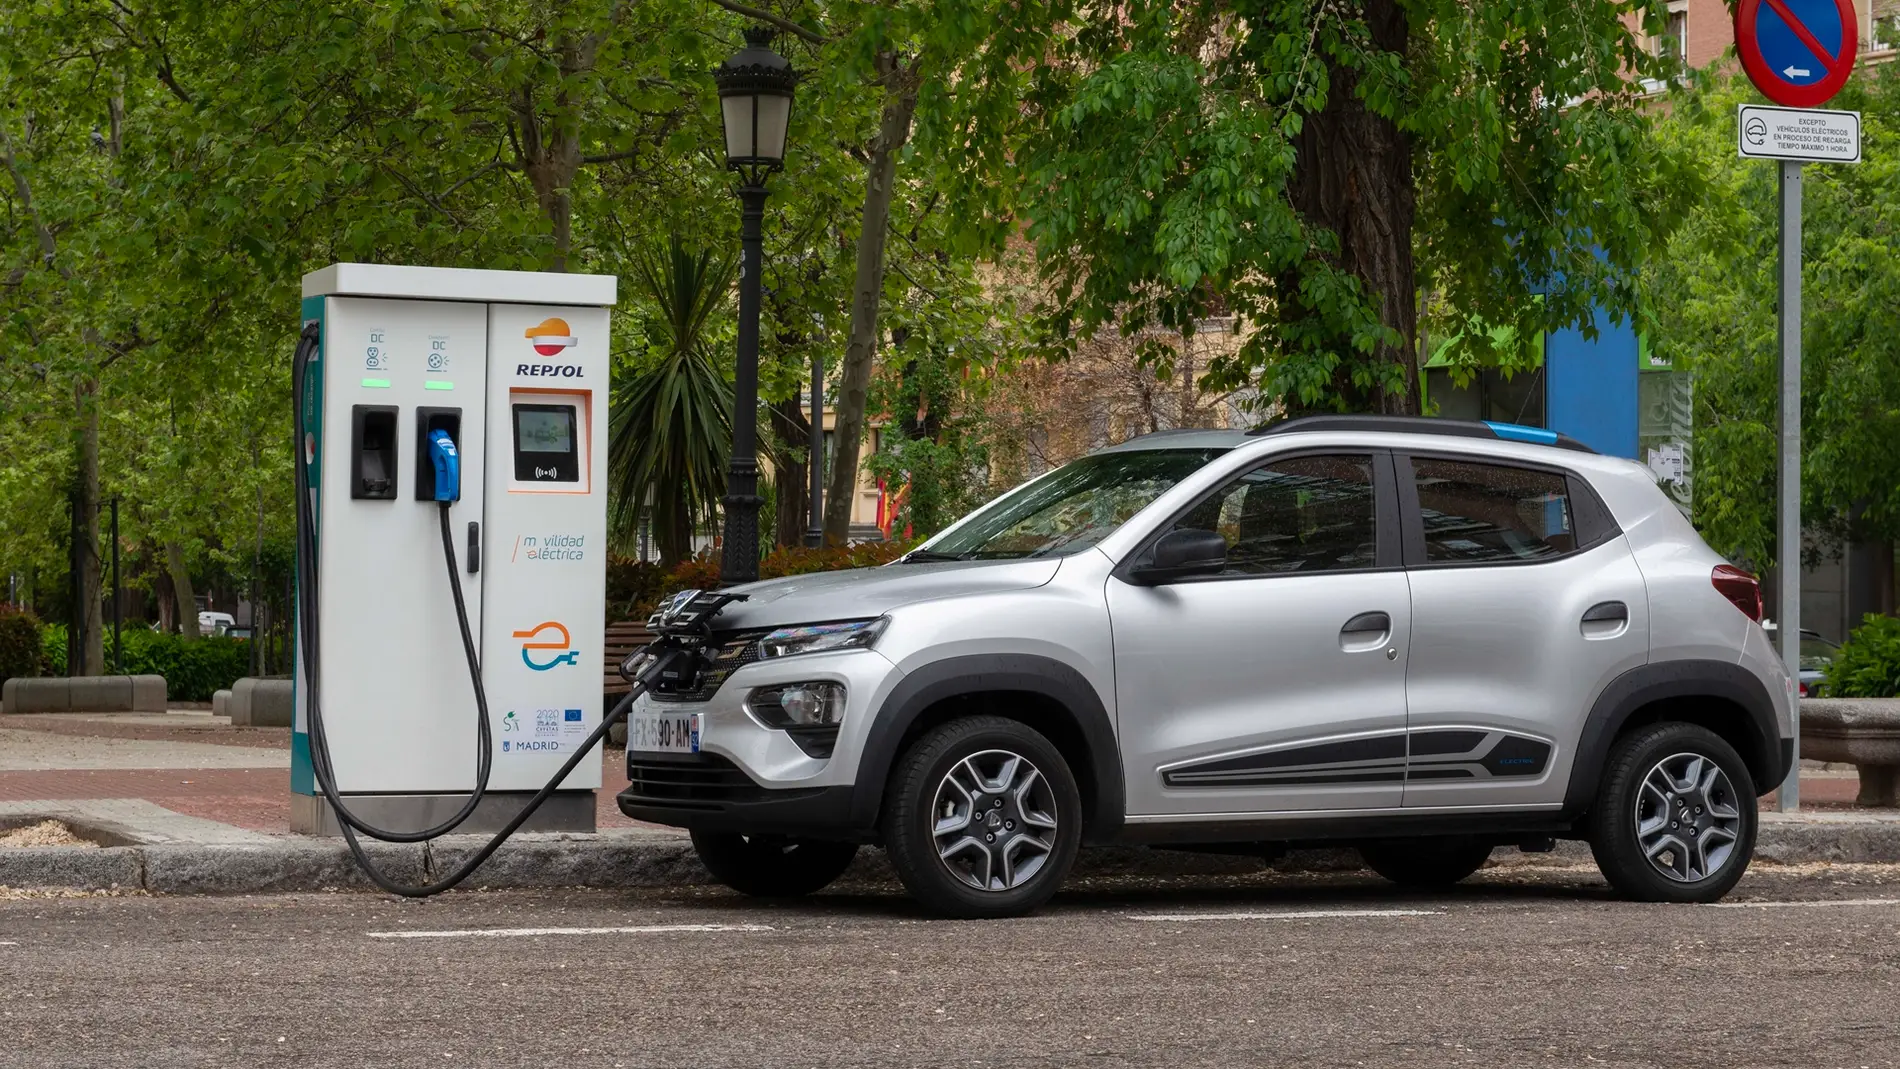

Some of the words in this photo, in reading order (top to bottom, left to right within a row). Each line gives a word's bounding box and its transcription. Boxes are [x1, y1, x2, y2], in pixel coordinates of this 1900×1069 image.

[1798, 118, 1826, 126] EXCEPTO
[1776, 125, 1810, 134] VEHÍCULOS
[1811, 126, 1848, 136] ELÉCTRICOS
[1783, 134, 1811, 142] PROCESO
[1801, 143, 1824, 151] MÁXIMO
[370, 333, 384, 343] DC
[432, 340, 446, 350] DC
[516, 364, 584, 377] REPSOL
[526, 547, 584, 560] eléctrica
[536, 709, 559, 719] 2020
[516, 741, 559, 751] MADRID
